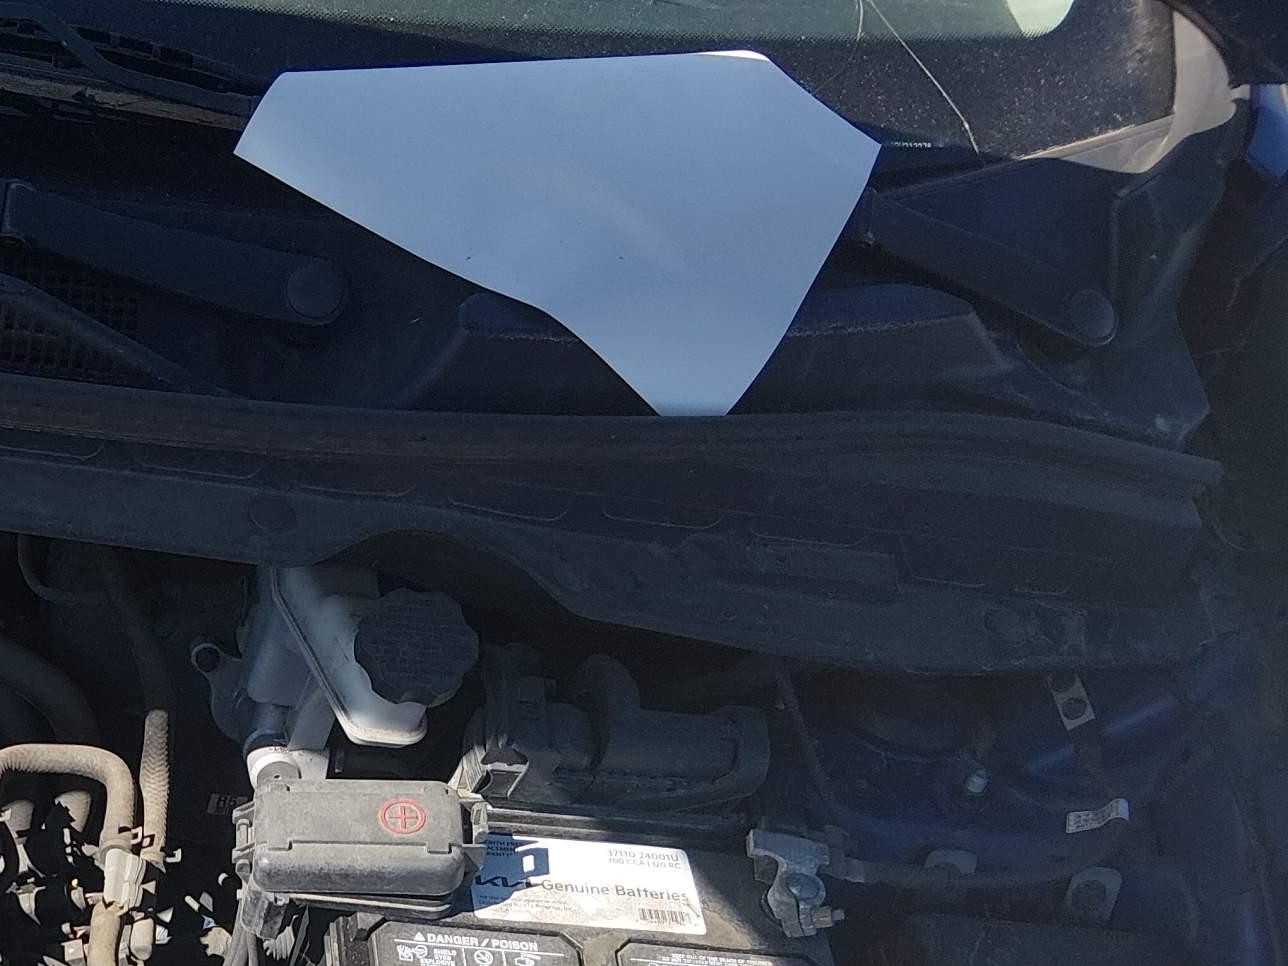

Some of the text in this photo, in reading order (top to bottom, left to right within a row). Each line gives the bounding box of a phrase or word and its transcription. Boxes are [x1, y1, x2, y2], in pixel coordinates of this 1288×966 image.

[542, 879, 609, 897] Genuine
[615, 884, 689, 903] Batteries
[427, 932, 479, 947] DANGER
[491, 938, 539, 952] POISON
